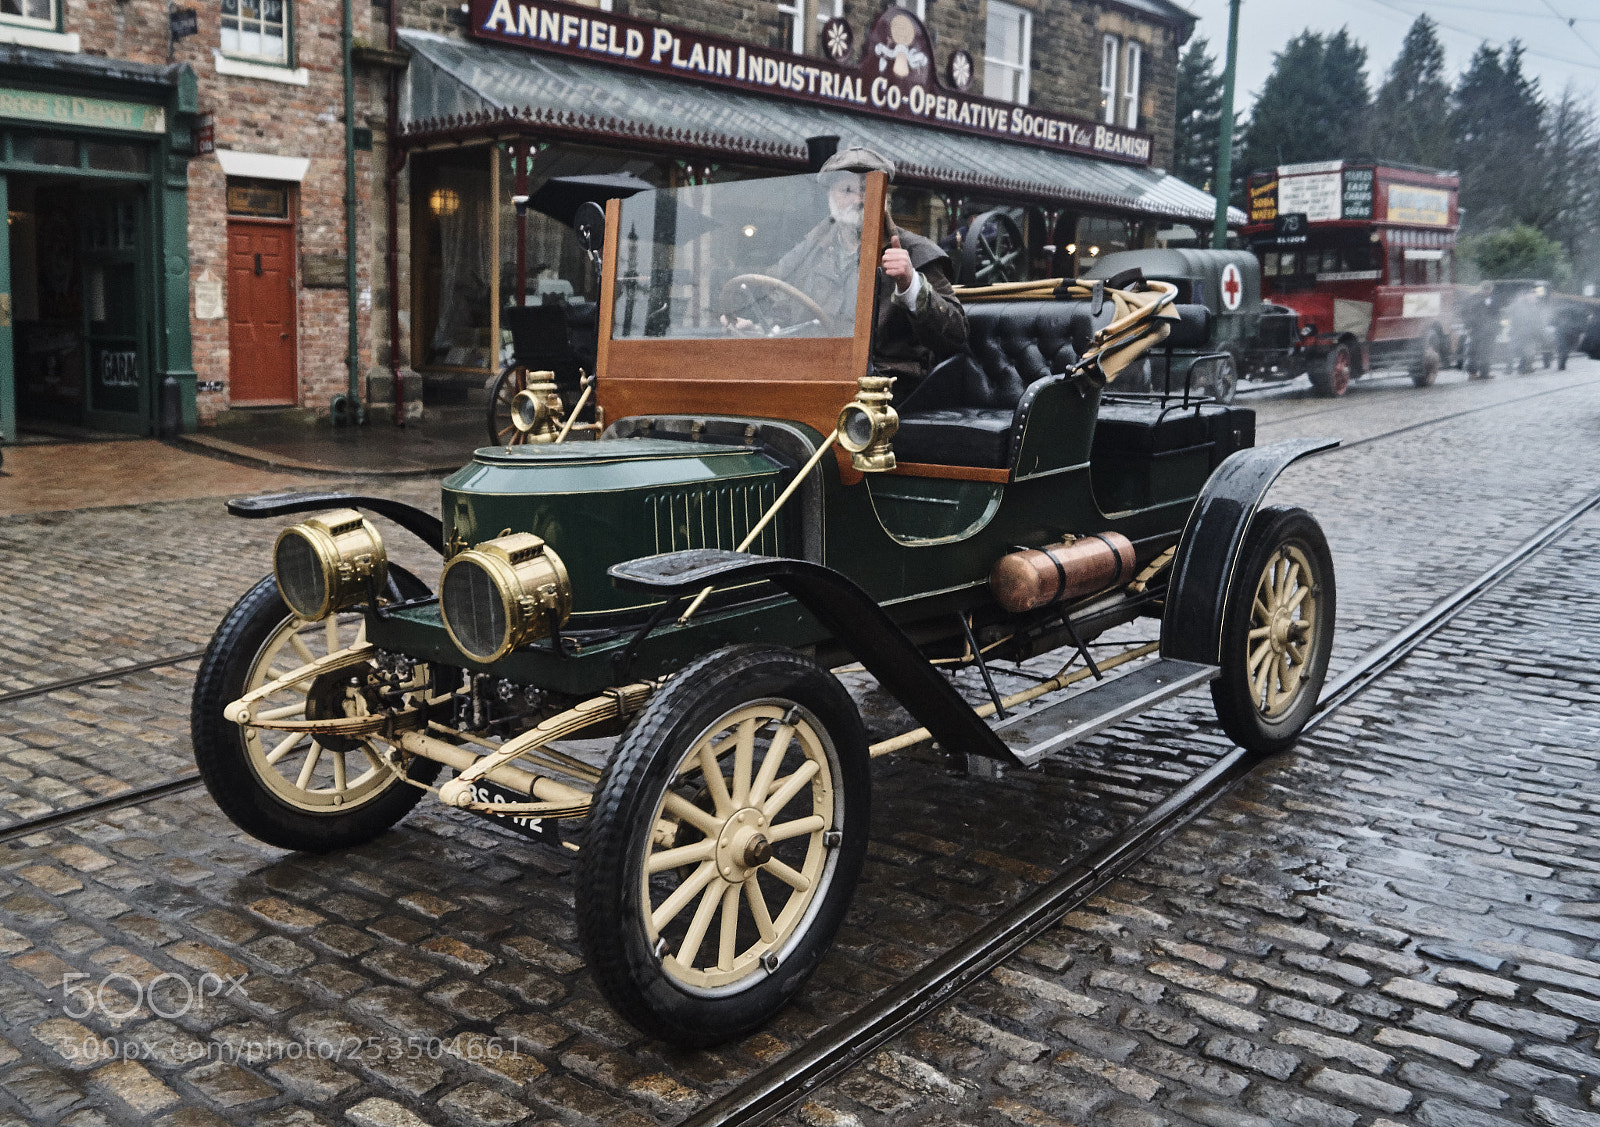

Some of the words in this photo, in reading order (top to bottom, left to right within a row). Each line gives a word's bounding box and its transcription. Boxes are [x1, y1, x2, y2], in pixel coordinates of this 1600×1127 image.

[484, 0, 645, 59] ANNFIELD
[651, 27, 732, 77] PLAIN
[736, 47, 867, 104] INDUSTRIAL
[871, 76, 1008, 132] CO-OPERATIVE
[1011, 108, 1079, 145] SOCIETY
[1094, 125, 1150, 160] BEAMISH
[1347, 182, 1371, 192] EASY
[1252, 197, 1275, 209] SODA
